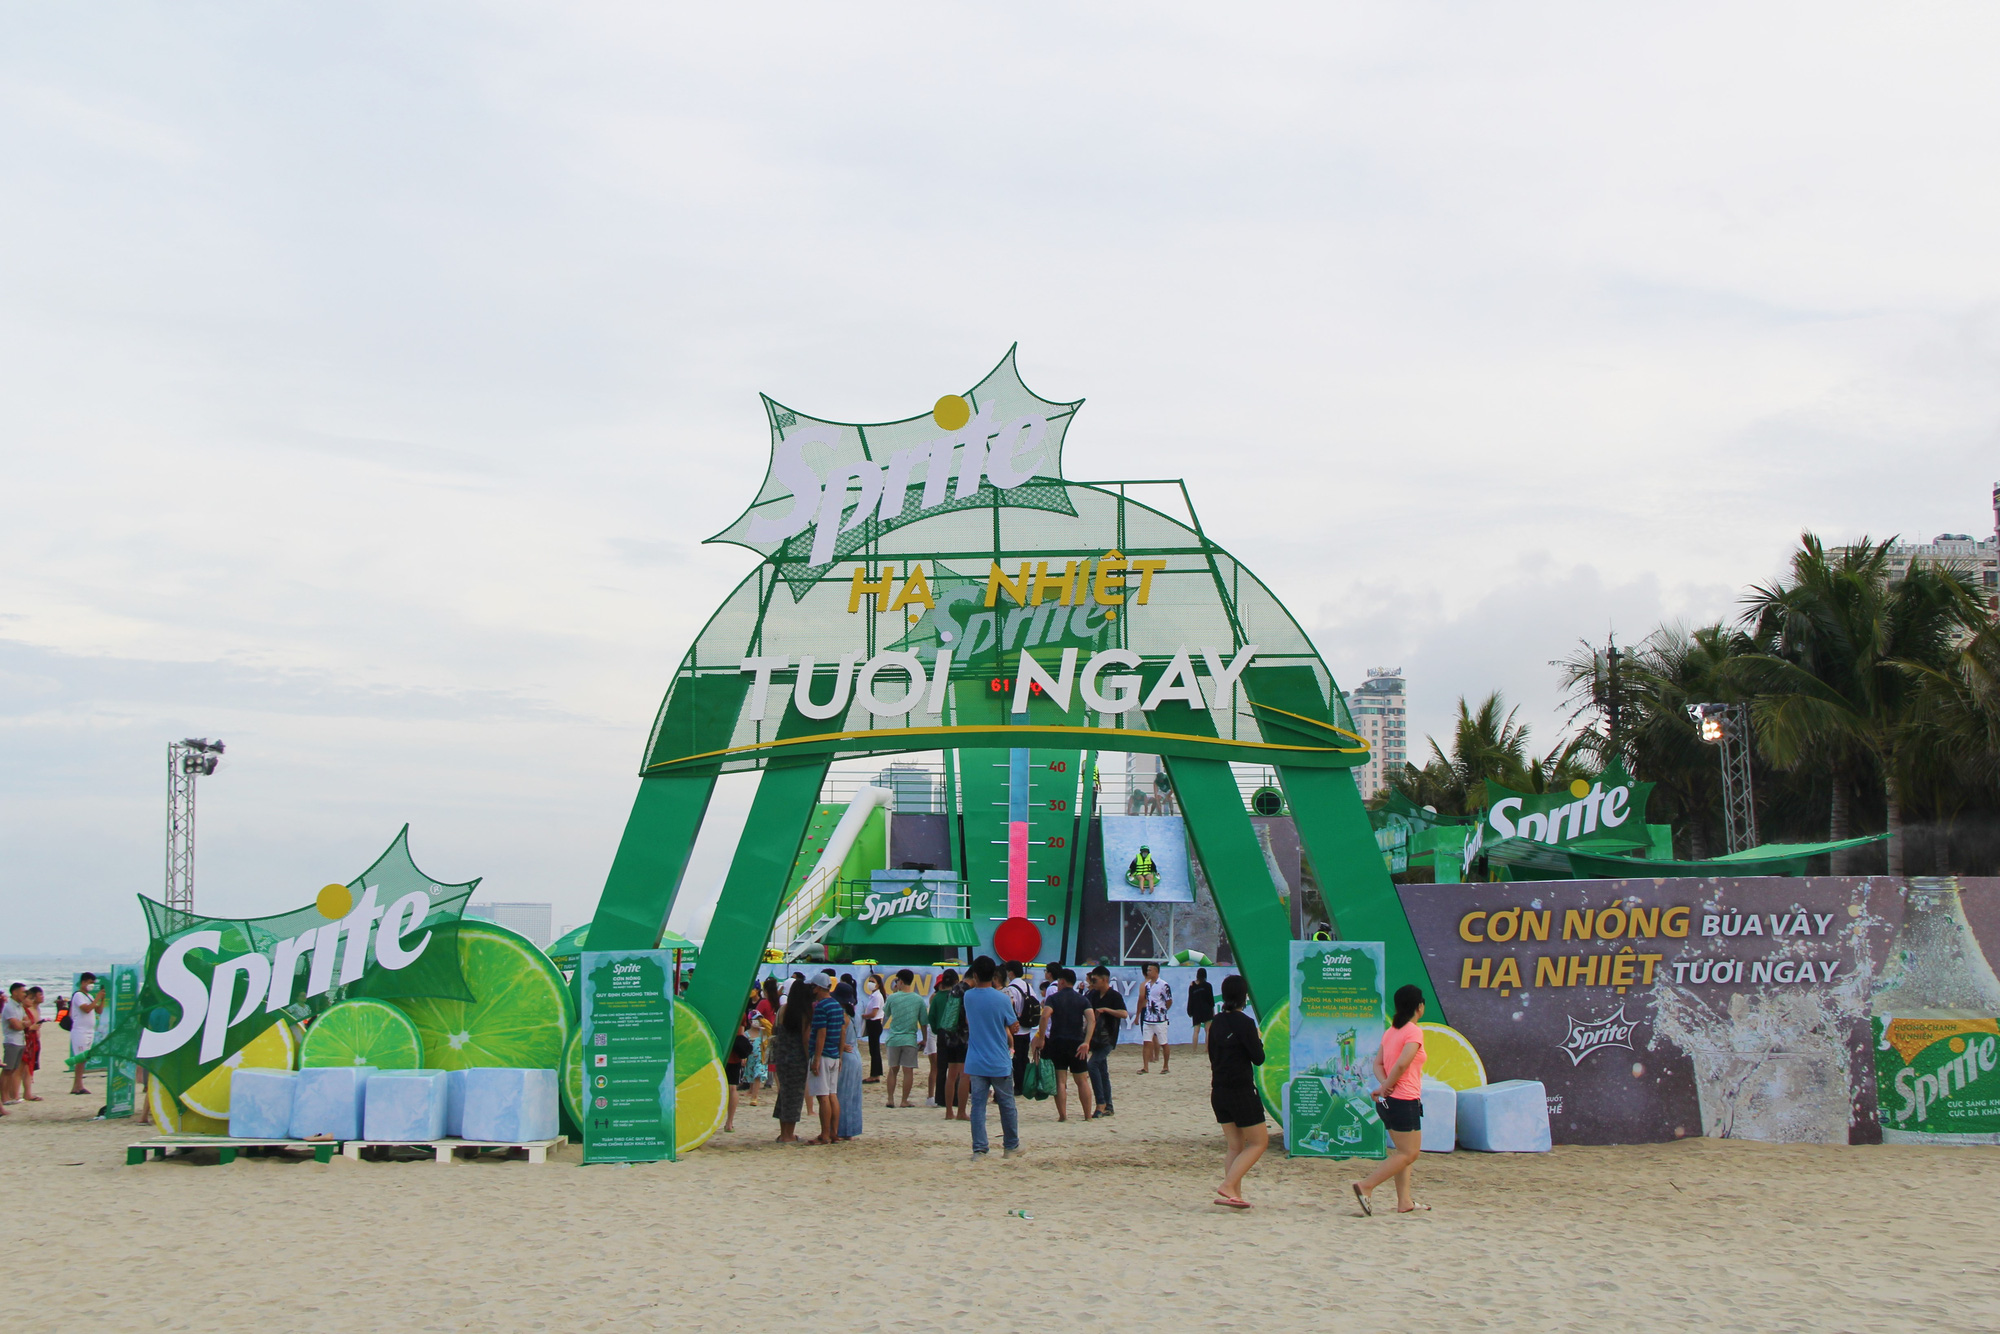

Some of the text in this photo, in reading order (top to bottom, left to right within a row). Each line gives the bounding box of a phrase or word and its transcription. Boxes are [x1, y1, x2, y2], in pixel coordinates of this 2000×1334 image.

[746, 394, 1047, 568] Sprite
[848, 548, 1167, 624] HẠ NHIỆT
[991, 678, 1009, 692] 61
[1011, 643, 1260, 715] NGAY
[1049, 761, 1066, 773] 40
[1049, 800, 1066, 811] 30
[1489, 779, 1631, 845] Sprite
[1048, 837, 1065, 848] 20
[1047, 875, 1061, 887] 10
[858, 887, 929, 925] Sprite
[1047, 914, 1056, 926] 0
[1459, 900, 1834, 942] CƠN NÓNG BỦA VÂY
[136, 883, 432, 1066] Sprite
[613, 963, 641, 975] Sprite
[1322, 954, 1352, 966] Sprite
[1460, 946, 1840, 998] HẠ NHIỆT TƯƠI NGAY
[1568, 1022, 1628, 1049] Sprite
[1894, 1036, 1998, 1122] Sprite
